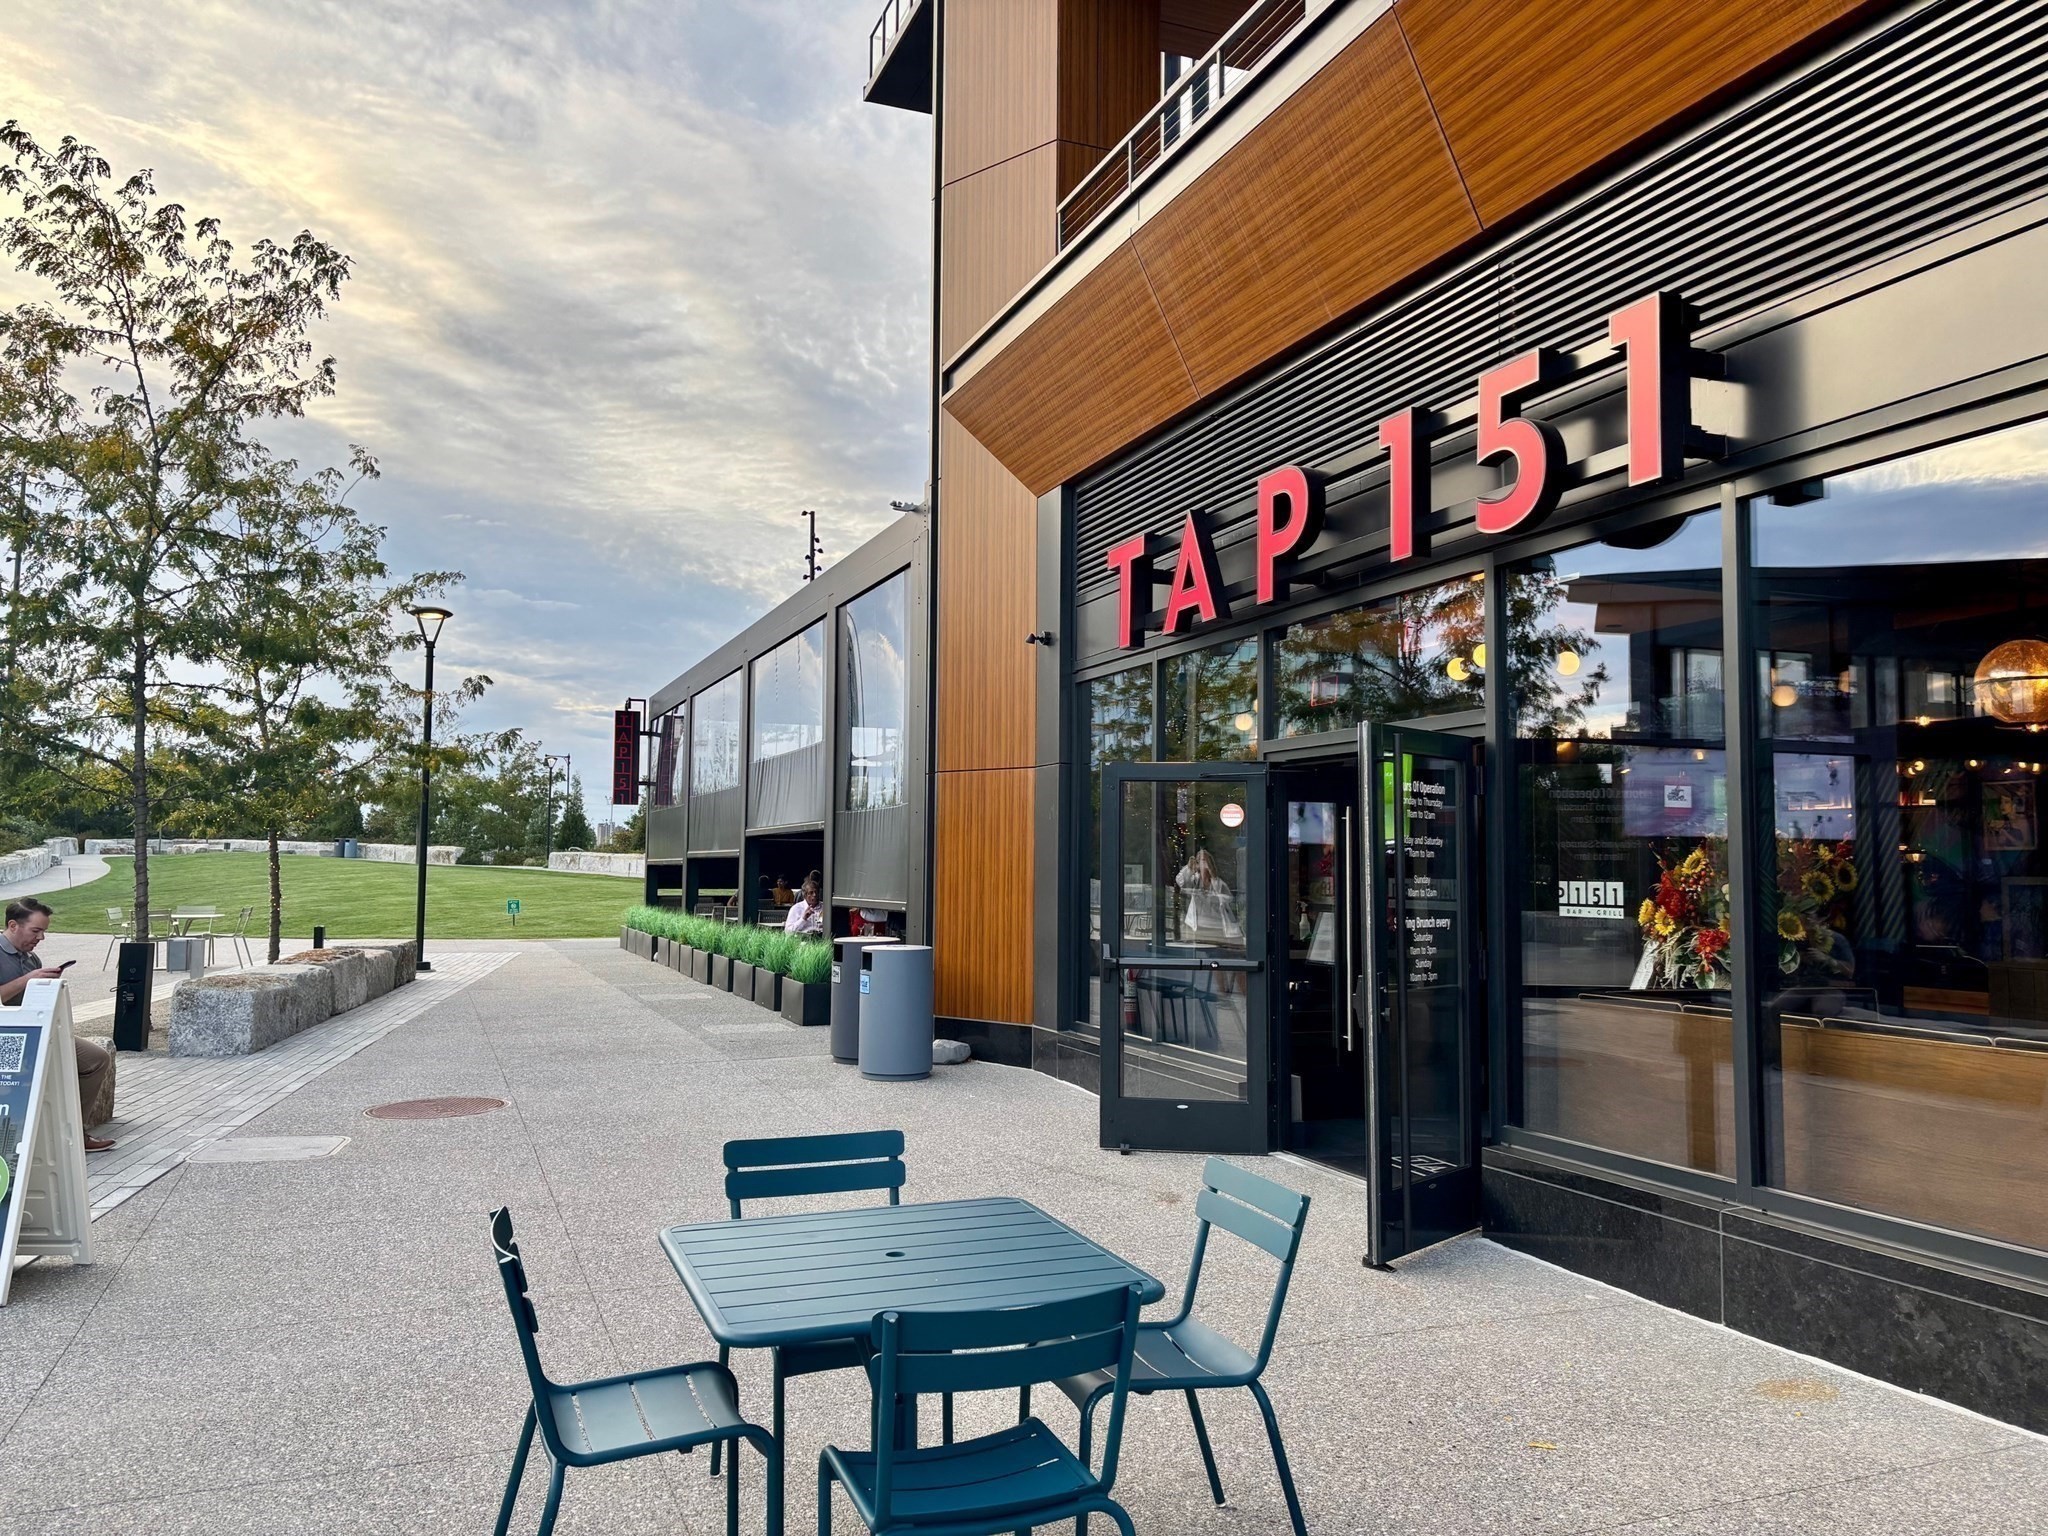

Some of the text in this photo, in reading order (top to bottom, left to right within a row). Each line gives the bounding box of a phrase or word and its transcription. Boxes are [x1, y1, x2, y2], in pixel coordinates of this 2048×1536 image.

[1107, 291, 1664, 649] TAP 151
[1412, 781, 1419, 792] Of
[1420, 782, 1445, 795] Operation
[1403, 796, 1444, 809] onday to Thursday
[1418, 810, 1423, 818] to
[1424, 810, 1436, 819] 12am
[1414, 835, 1423, 845] and
[1424, 836, 1443, 847] Saturday
[1420, 850, 1425, 858] to
[1413, 874, 1431, 885] Sunday
[1596, 909, 1622, 917] GRILL
[1416, 916, 1436, 928] Brunch
[1436, 918, 1450, 930] every
[1413, 932, 1433, 943] Saturday
[1427, 945, 1437, 956] 3pm
[1415, 959, 1432, 969] Sunday
[1428, 971, 1438, 982] 3pm
